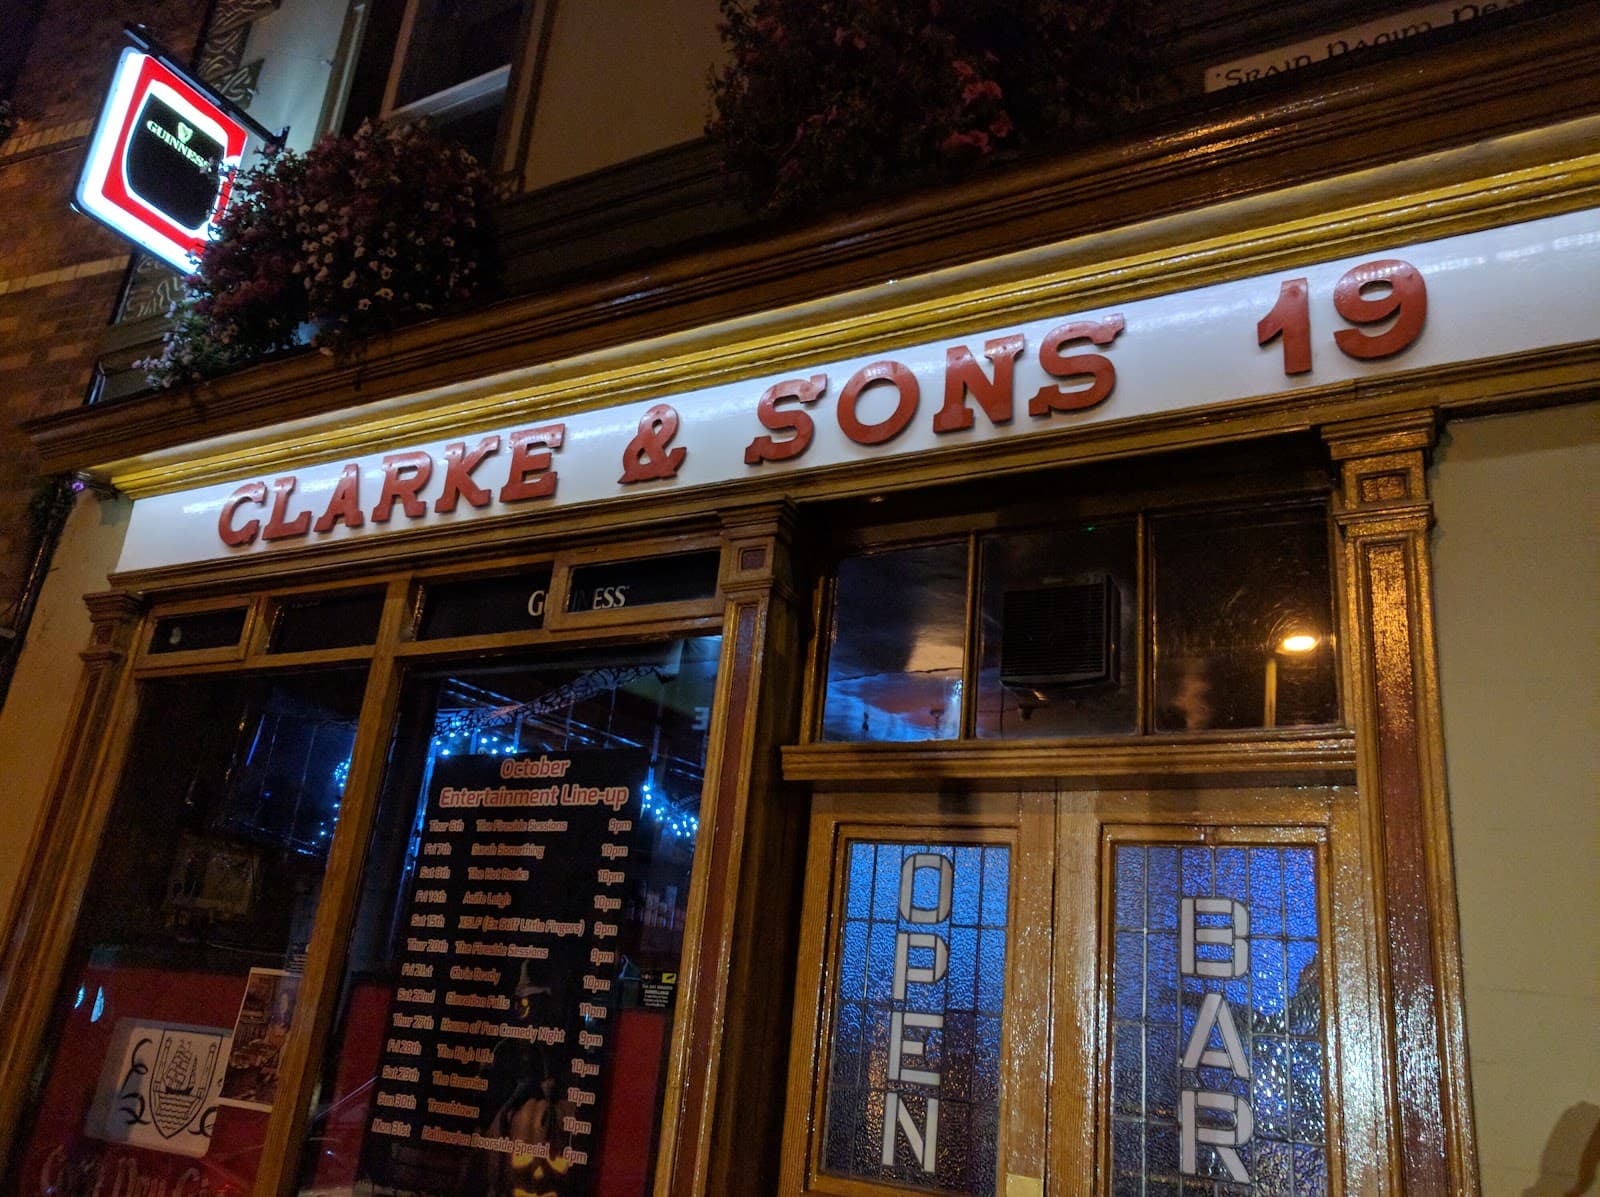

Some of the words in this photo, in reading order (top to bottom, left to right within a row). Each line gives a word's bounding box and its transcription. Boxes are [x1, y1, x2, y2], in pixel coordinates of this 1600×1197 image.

[218, 423, 565, 546] CLARKE
[617, 403, 687, 484] &
[744, 313, 1125, 464] SONS
[1257, 258, 1428, 375] 19
[500, 756, 571, 779] October
[439, 785, 559, 808] Entertainment
[560, 784, 629, 811] Line-up
[528, 819, 567, 832] Sessions
[609, 818, 632, 834] 9pm
[602, 843, 628, 860] 10pm
[598, 869, 625, 885] 10pm
[594, 894, 621, 911] 10pm
[520, 918, 545, 932] Little
[545, 919, 585, 937] Fingers)
[594, 921, 618, 939] 9pm
[508, 944, 549, 959] Sessions
[590, 948, 615, 966] 9pm
[583, 975, 611, 993] 10pm
[579, 1002, 607, 1019] 10pm
[881, 853, 953, 1174] OPEN
[499, 1023, 537, 1042] Comedy
[537, 1026, 566, 1045] Night
[579, 1031, 603, 1048] 9pm
[1179, 896, 1253, 1185] BAR
[571, 1058, 600, 1078] 10pm
[567, 1087, 596, 1107] 10pm
[563, 1117, 592, 1135] 10pm
[514, 1138, 550, 1159] Special
[563, 1146, 588, 1167] 6pm
